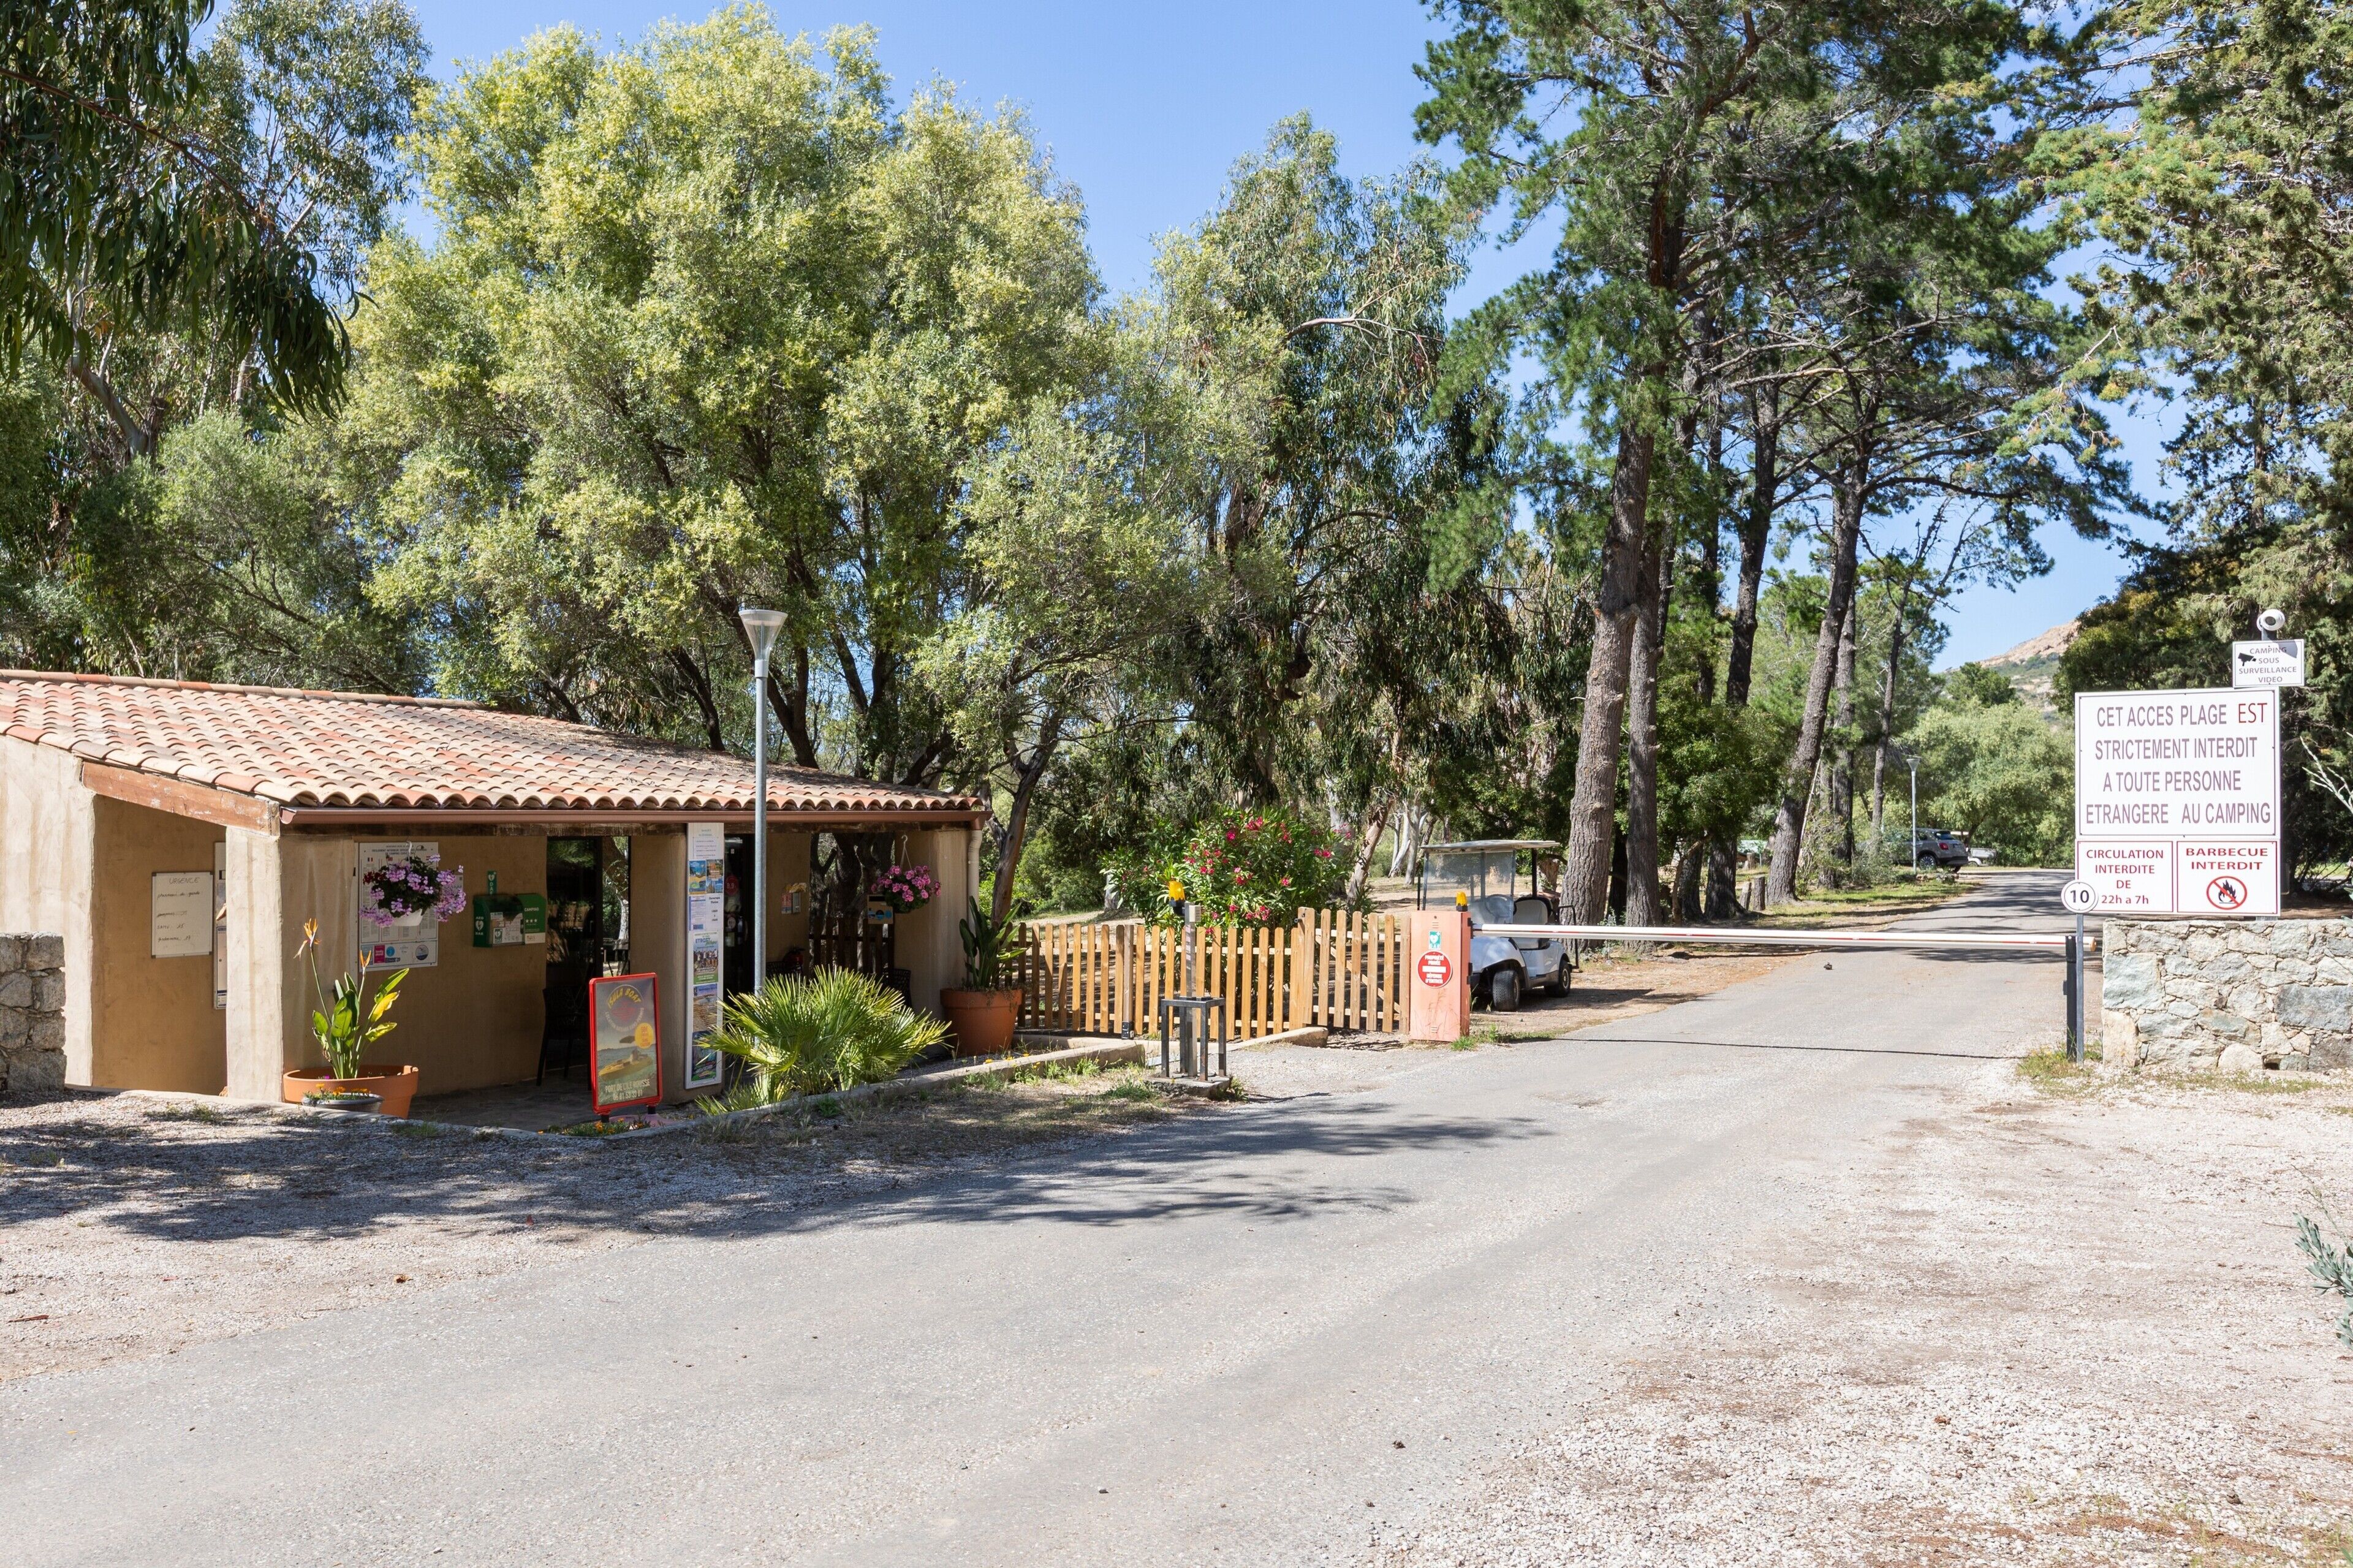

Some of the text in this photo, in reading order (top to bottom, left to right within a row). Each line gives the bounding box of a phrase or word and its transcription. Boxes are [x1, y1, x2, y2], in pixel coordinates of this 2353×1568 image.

[2097, 702, 2268, 727] CET ACCES PLAGE EST
[2095, 737, 2257, 760] STRICTEMENT INTERDIT
[2103, 770, 2241, 792] A TOUTE PERSONNE
[2086, 803, 2270, 824] ETRANGERE AU CAMPING
[2086, 849, 2164, 859] CIRCULATION
[2186, 848, 2268, 857] BARBECUE
[2095, 865, 2155, 874] INTERDITE
[2191, 862, 2263, 870] INTERDIT
[2116, 880, 2131, 889] DE
[2071, 890, 2090, 903] 10
[2101, 895, 2122, 904] 22h
[2135, 895, 2149, 904] 7h
[624, 988, 642, 1004] BOAT
[605, 1085, 615, 1093] PORT
[616, 1083, 623, 1092] DE
